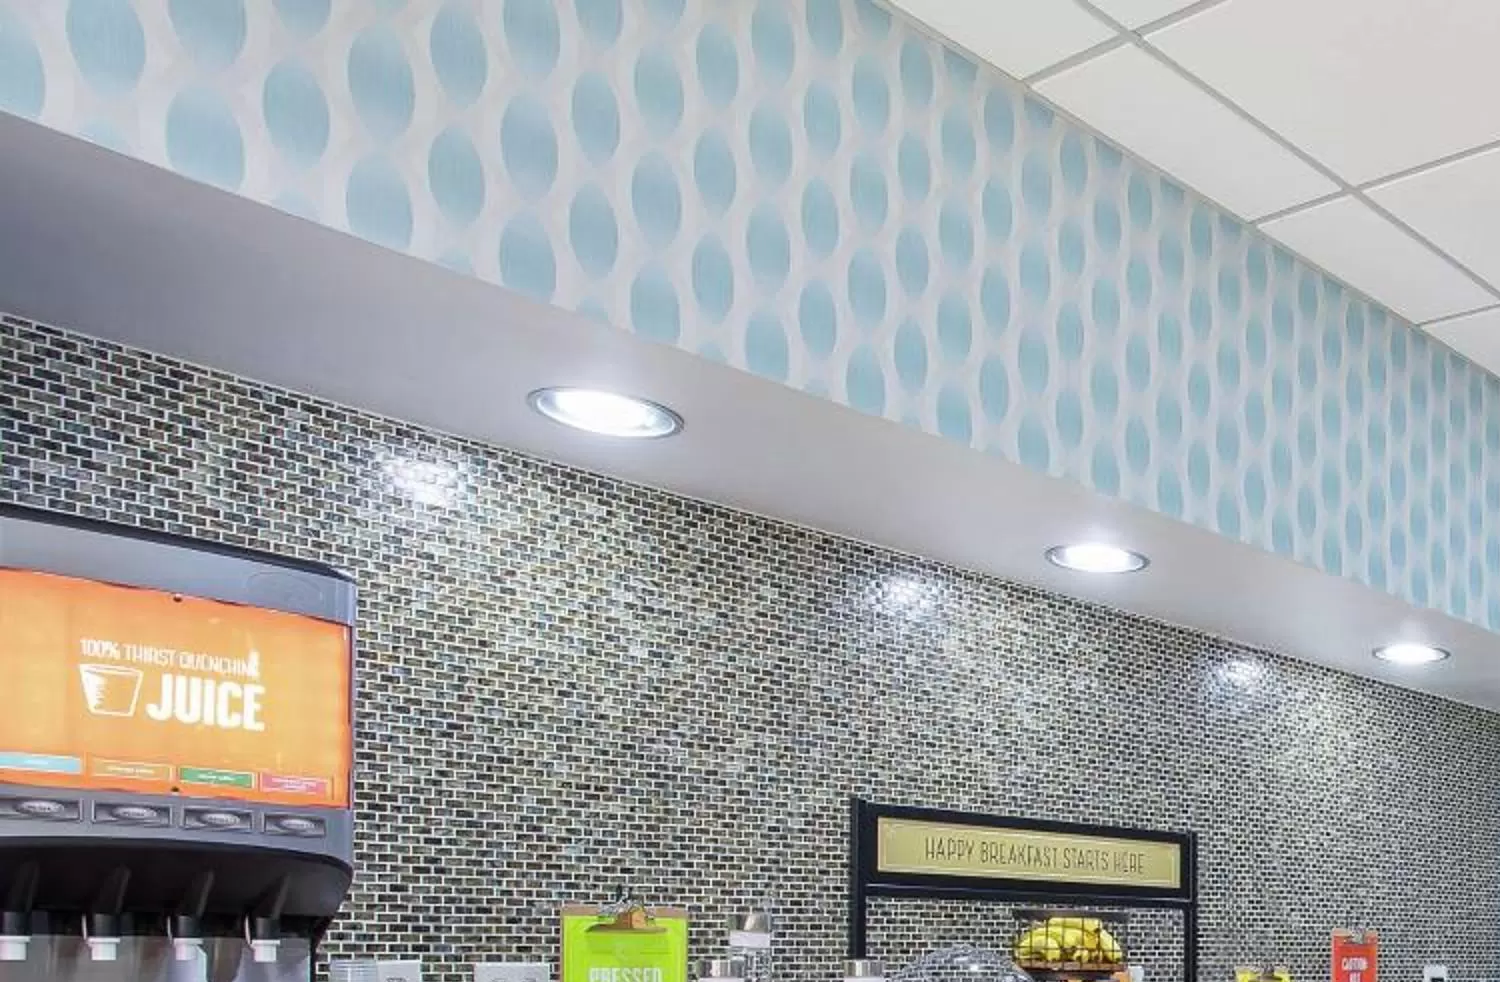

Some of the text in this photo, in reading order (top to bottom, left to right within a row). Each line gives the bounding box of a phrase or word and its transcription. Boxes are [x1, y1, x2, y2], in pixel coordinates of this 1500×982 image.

[80, 638, 120, 660] 100%
[124, 643, 176, 667] THIRST
[145, 672, 266, 732] JUICE
[925, 836, 1145, 875] HAPPY BREAKFAST STARTS HERE
